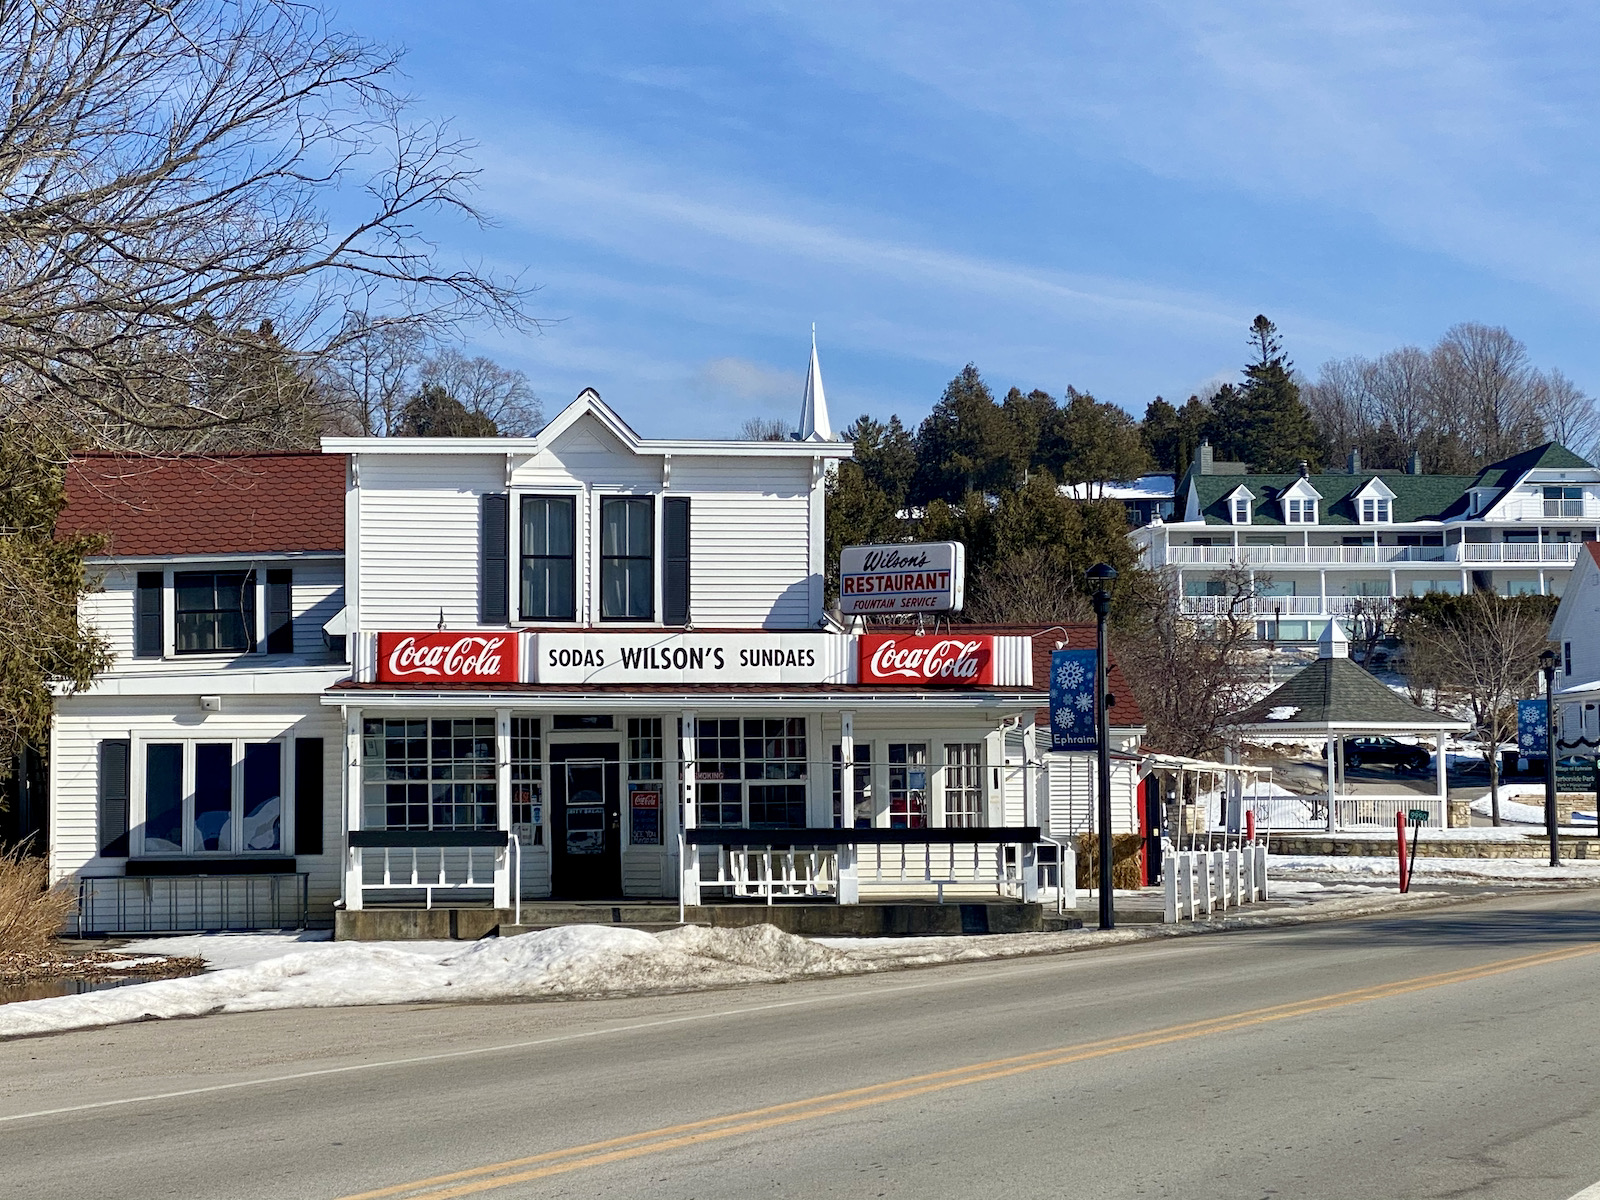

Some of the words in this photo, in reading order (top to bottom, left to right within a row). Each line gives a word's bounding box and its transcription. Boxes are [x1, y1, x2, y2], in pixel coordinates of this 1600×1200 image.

[863, 550, 931, 571] Wilson's
[844, 572, 949, 594] RESTAURANT
[853, 599, 896, 610] FOUNTAIN
[900, 597, 938, 608] SERVICE
[388, 637, 506, 676] Coca-Cola
[549, 649, 605, 667] SODAS
[620, 647, 725, 670] WILSON'S
[740, 649, 815, 667] SUNDAES
[870, 640, 983, 678] Coca-Cola
[1053, 733, 1095, 746] Ephraim
[1520, 748, 1547, 756] Ephraim
